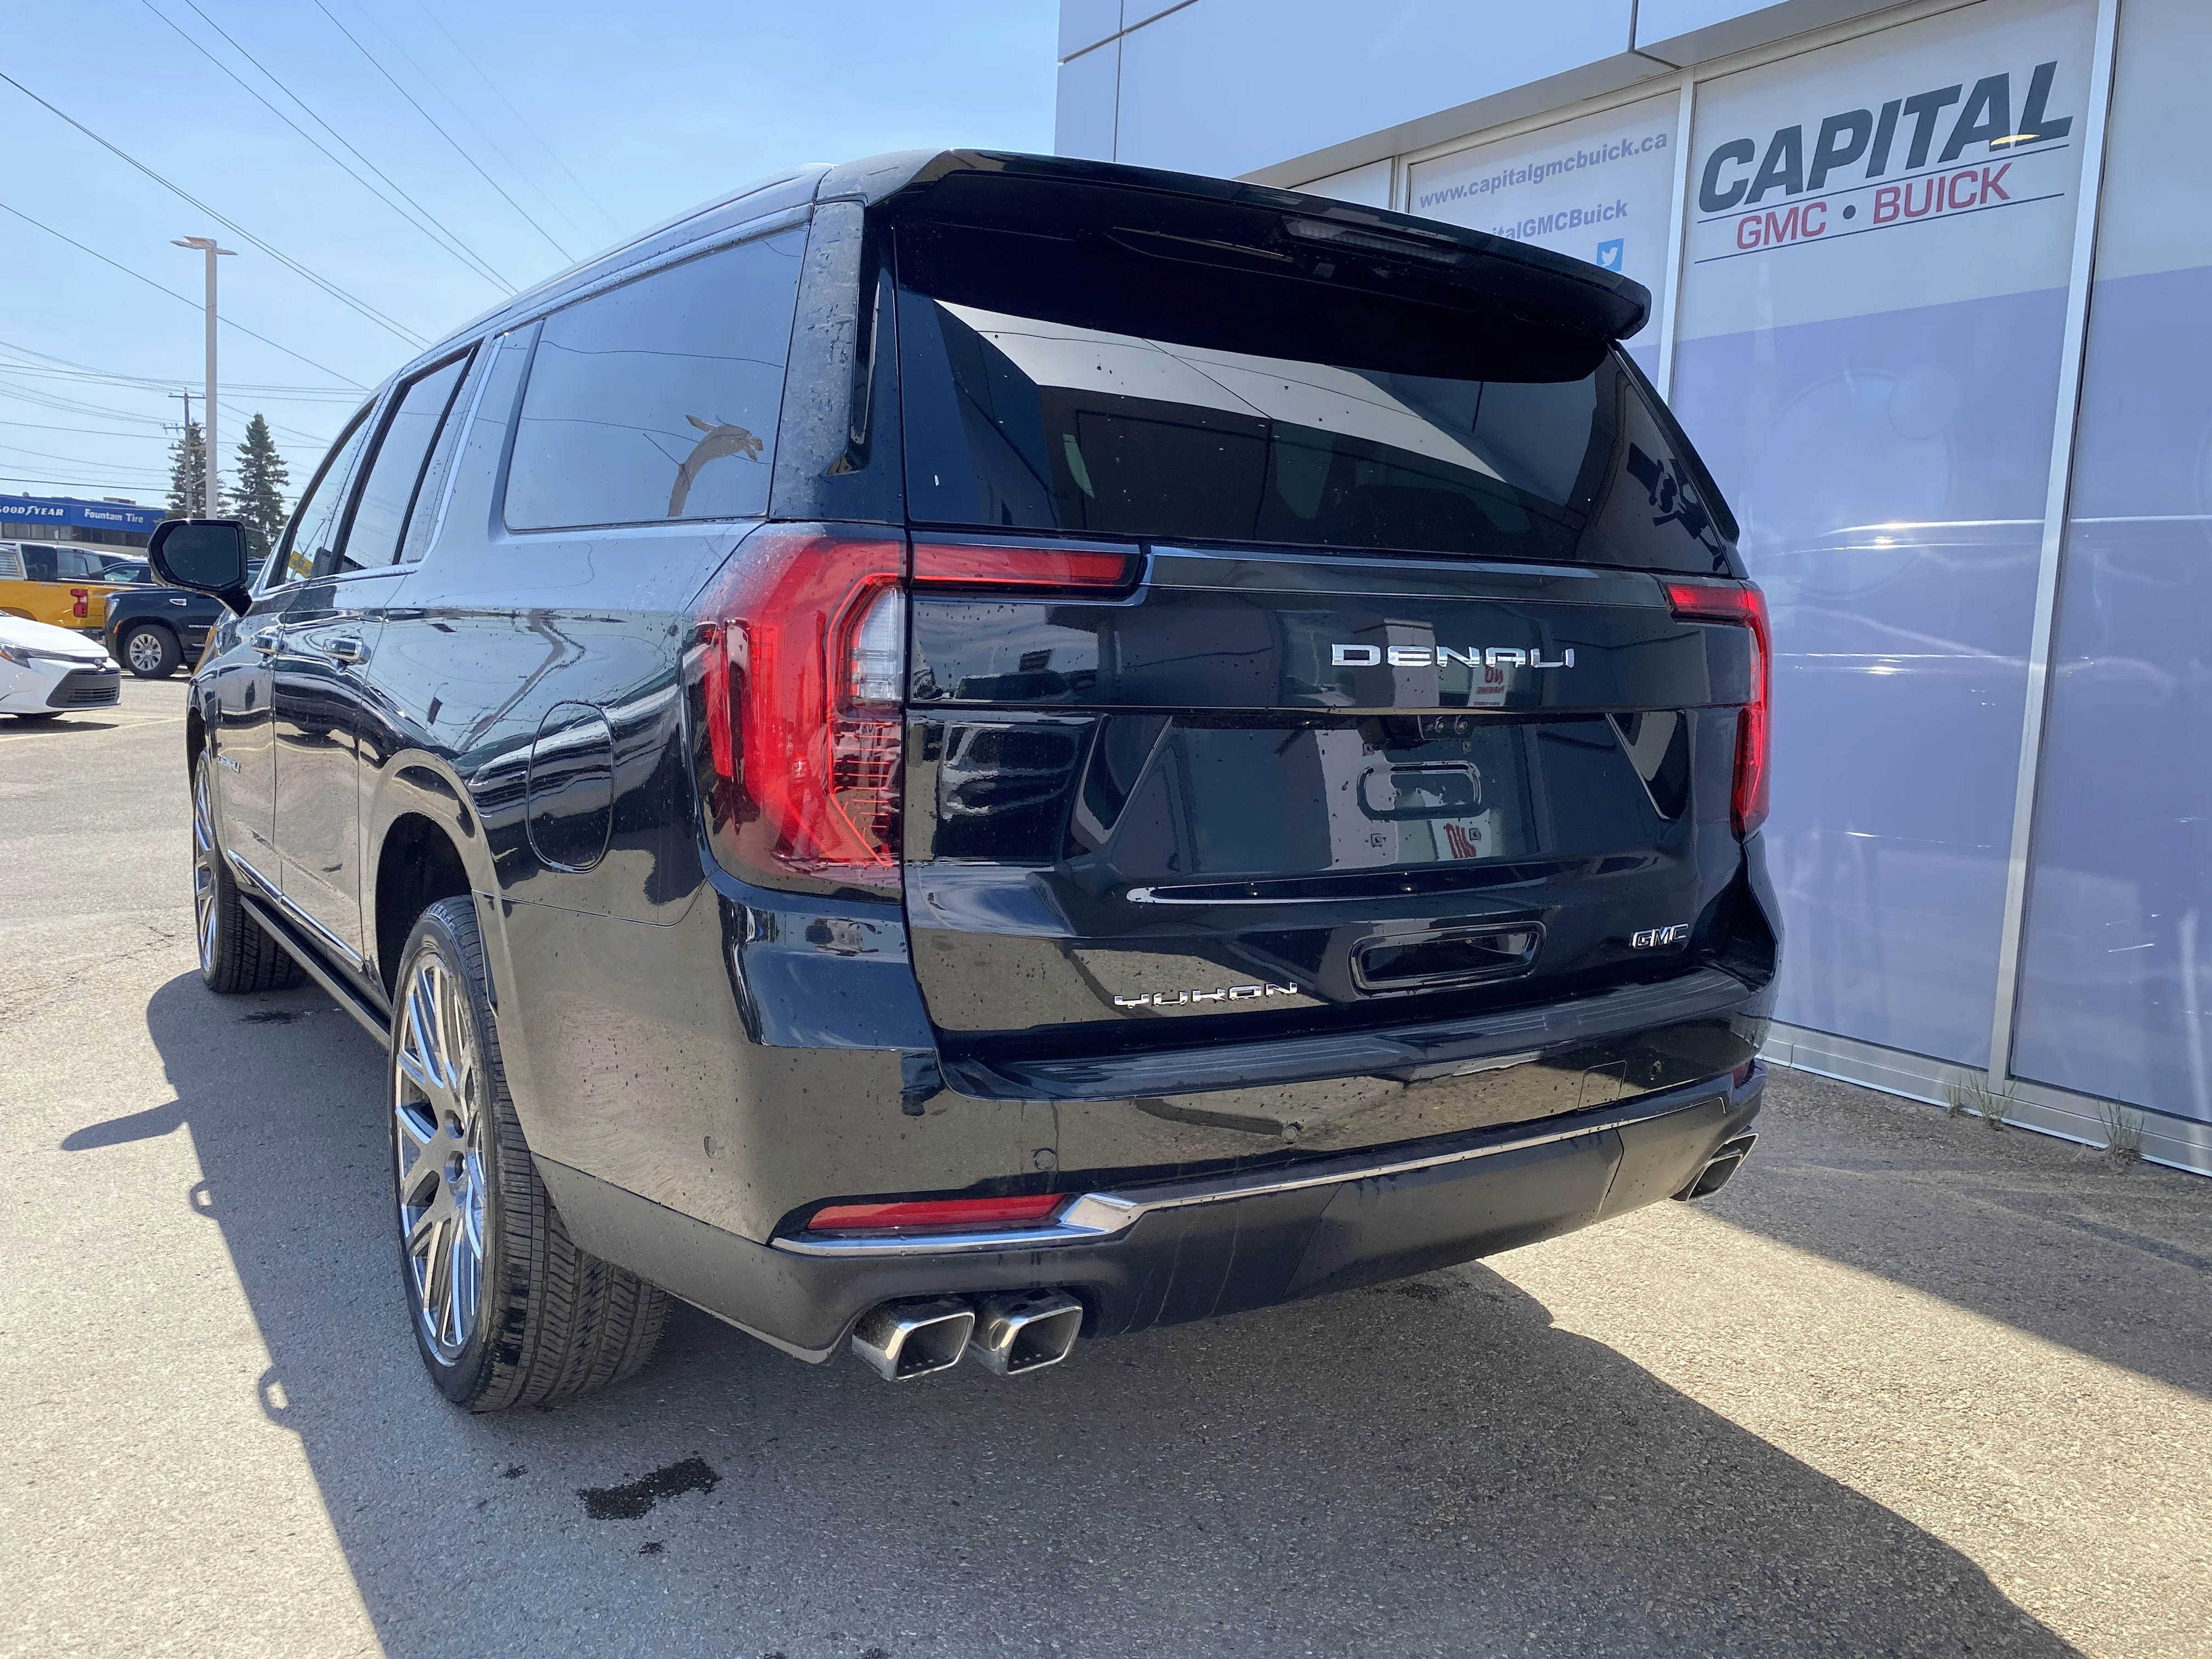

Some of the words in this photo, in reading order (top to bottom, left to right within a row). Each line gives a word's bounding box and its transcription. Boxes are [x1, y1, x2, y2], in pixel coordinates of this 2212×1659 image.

[1699, 60, 2073, 213] CAPITAL
[1419, 133, 1667, 208] www.capitalgmcbuick.ca
[1493, 199, 1628, 240] talGMCBuick
[1737, 201, 1827, 249] GMC
[1873, 162, 2013, 224] BUICK
[84, 509, 122, 521] Fountain
[126, 513, 144, 523] Tire
[1331, 643, 1575, 668] DENALI
[1632, 923, 1689, 950] GMC
[1114, 982, 1298, 1009] YUKON
